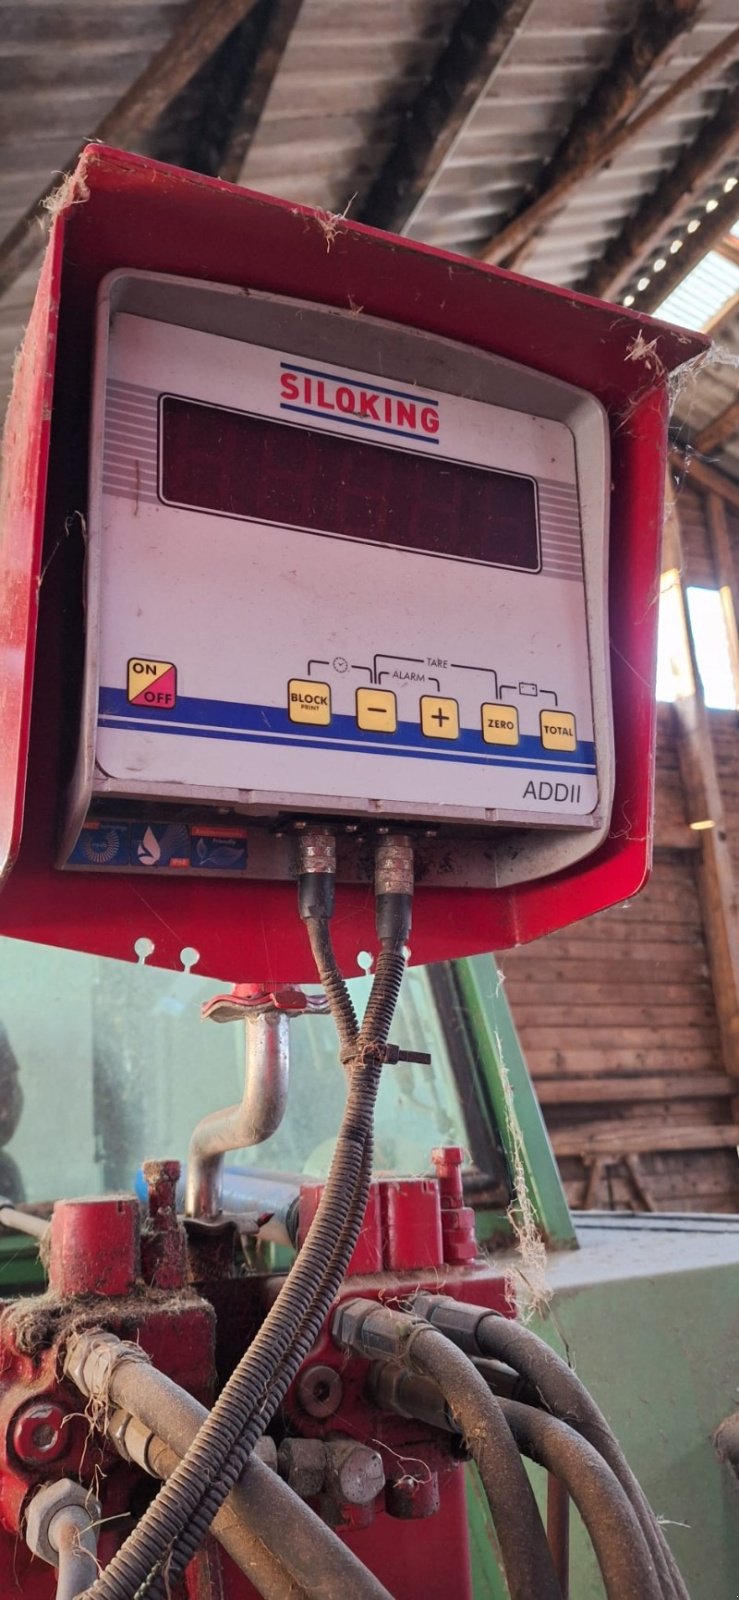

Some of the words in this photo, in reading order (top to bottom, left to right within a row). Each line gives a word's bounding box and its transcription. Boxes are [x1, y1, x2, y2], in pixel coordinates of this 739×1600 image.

[280, 372, 440, 434] SILOKING
[132, 662, 157, 676] ON
[426, 657, 448, 669] TARE
[392, 670, 426, 682] ALARM
[143, 691, 173, 705] OFF
[290, 692, 328, 706] BLOCK
[300, 703, 320, 712] PRINT
[487, 718, 515, 730] ZERO
[543, 725, 574, 737] TOTAL
[522, 780, 582, 804] ADDII
